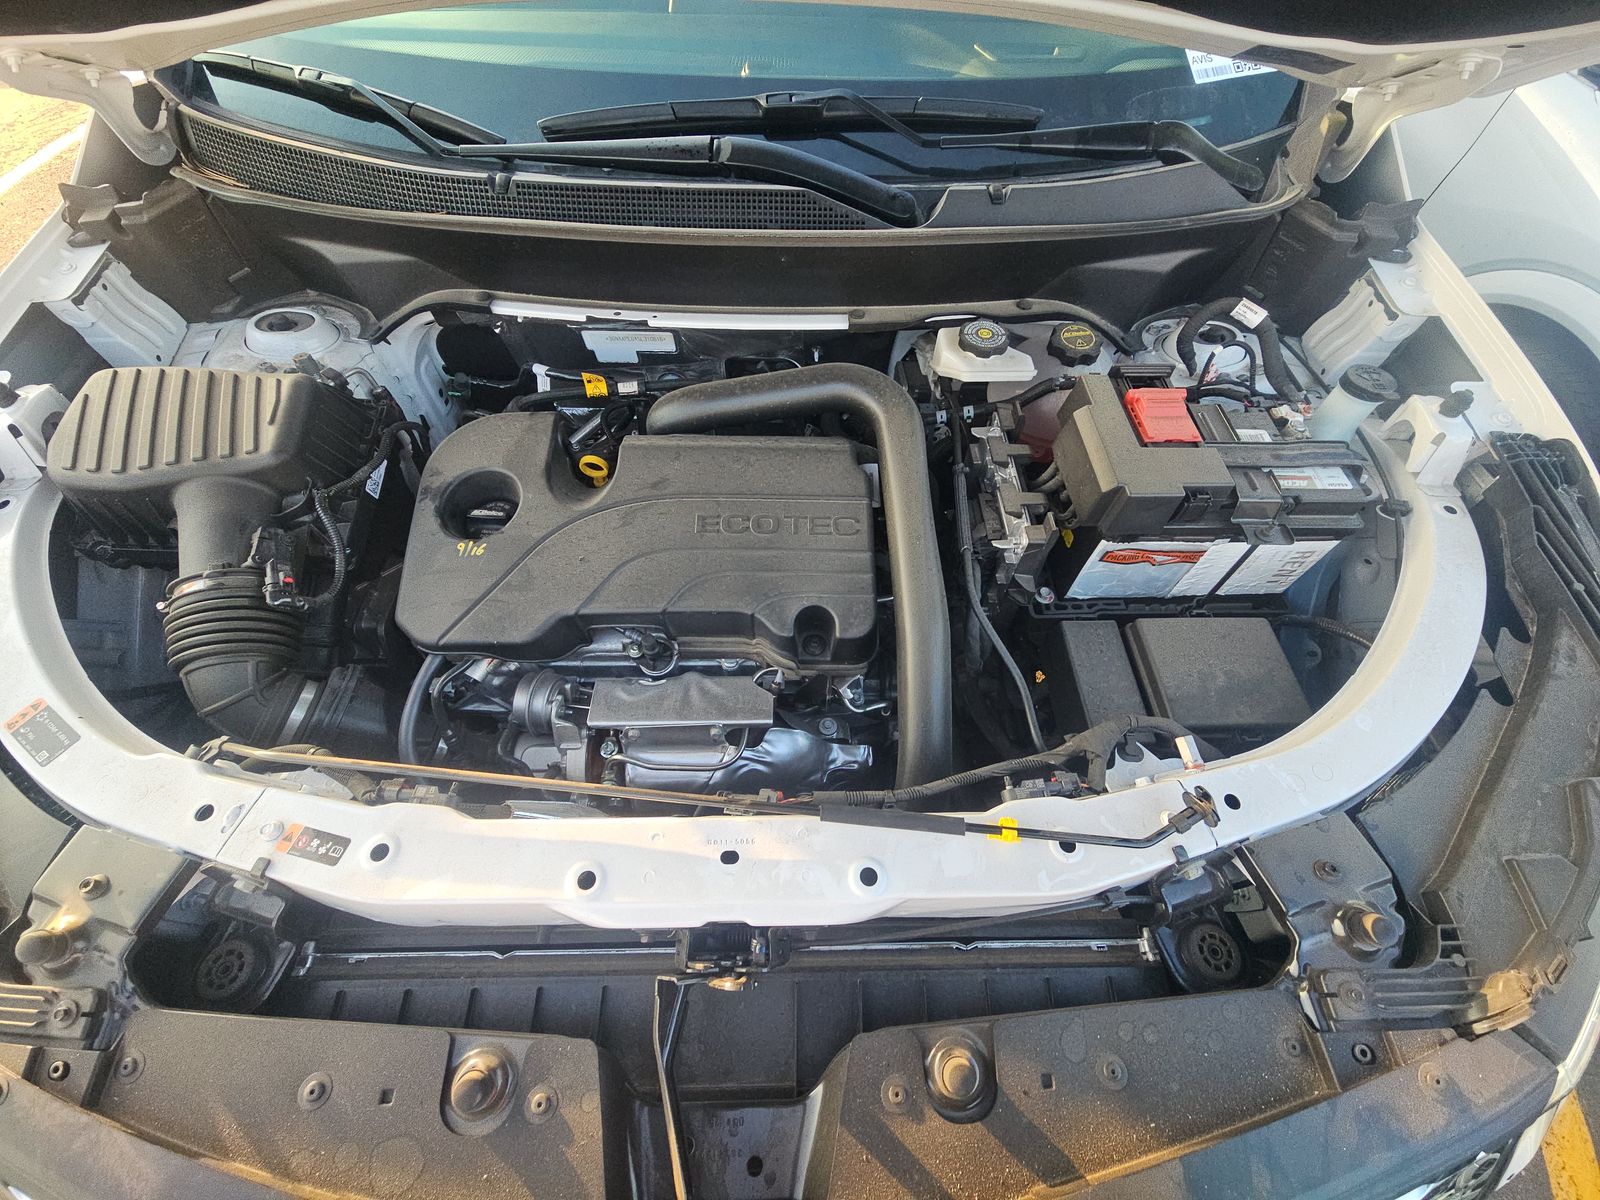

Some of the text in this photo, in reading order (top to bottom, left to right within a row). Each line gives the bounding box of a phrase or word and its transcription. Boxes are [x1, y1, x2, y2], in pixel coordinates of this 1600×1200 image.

[1191, 53, 1213, 65] AVIS
[694, 513, 861, 537] ECOTEC
[456, 541, 487, 557] 9/16
